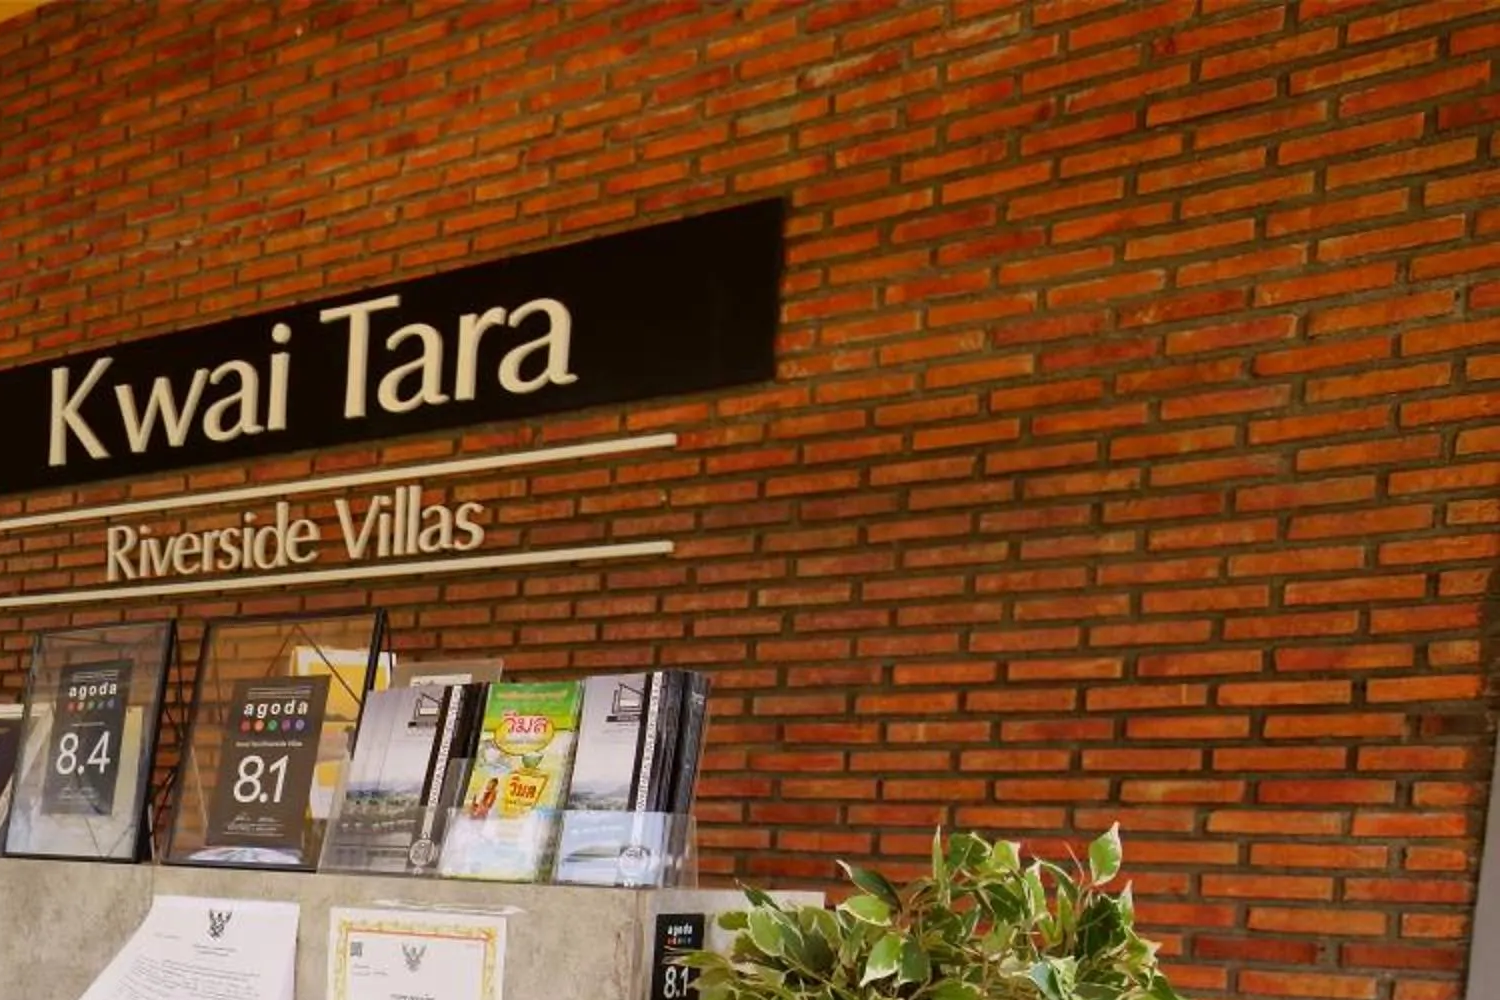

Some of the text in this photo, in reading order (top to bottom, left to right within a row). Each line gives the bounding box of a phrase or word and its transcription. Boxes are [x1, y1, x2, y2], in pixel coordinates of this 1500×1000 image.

[48, 294, 580, 467] Kwai Tara
[106, 484, 486, 582] Riverside Villas
[68, 682, 118, 700] agoda
[243, 699, 309, 718] agoda
[56, 730, 111, 775] 8.4
[233, 754, 290, 803] 8.1
[663, 965, 690, 999] 8.1
